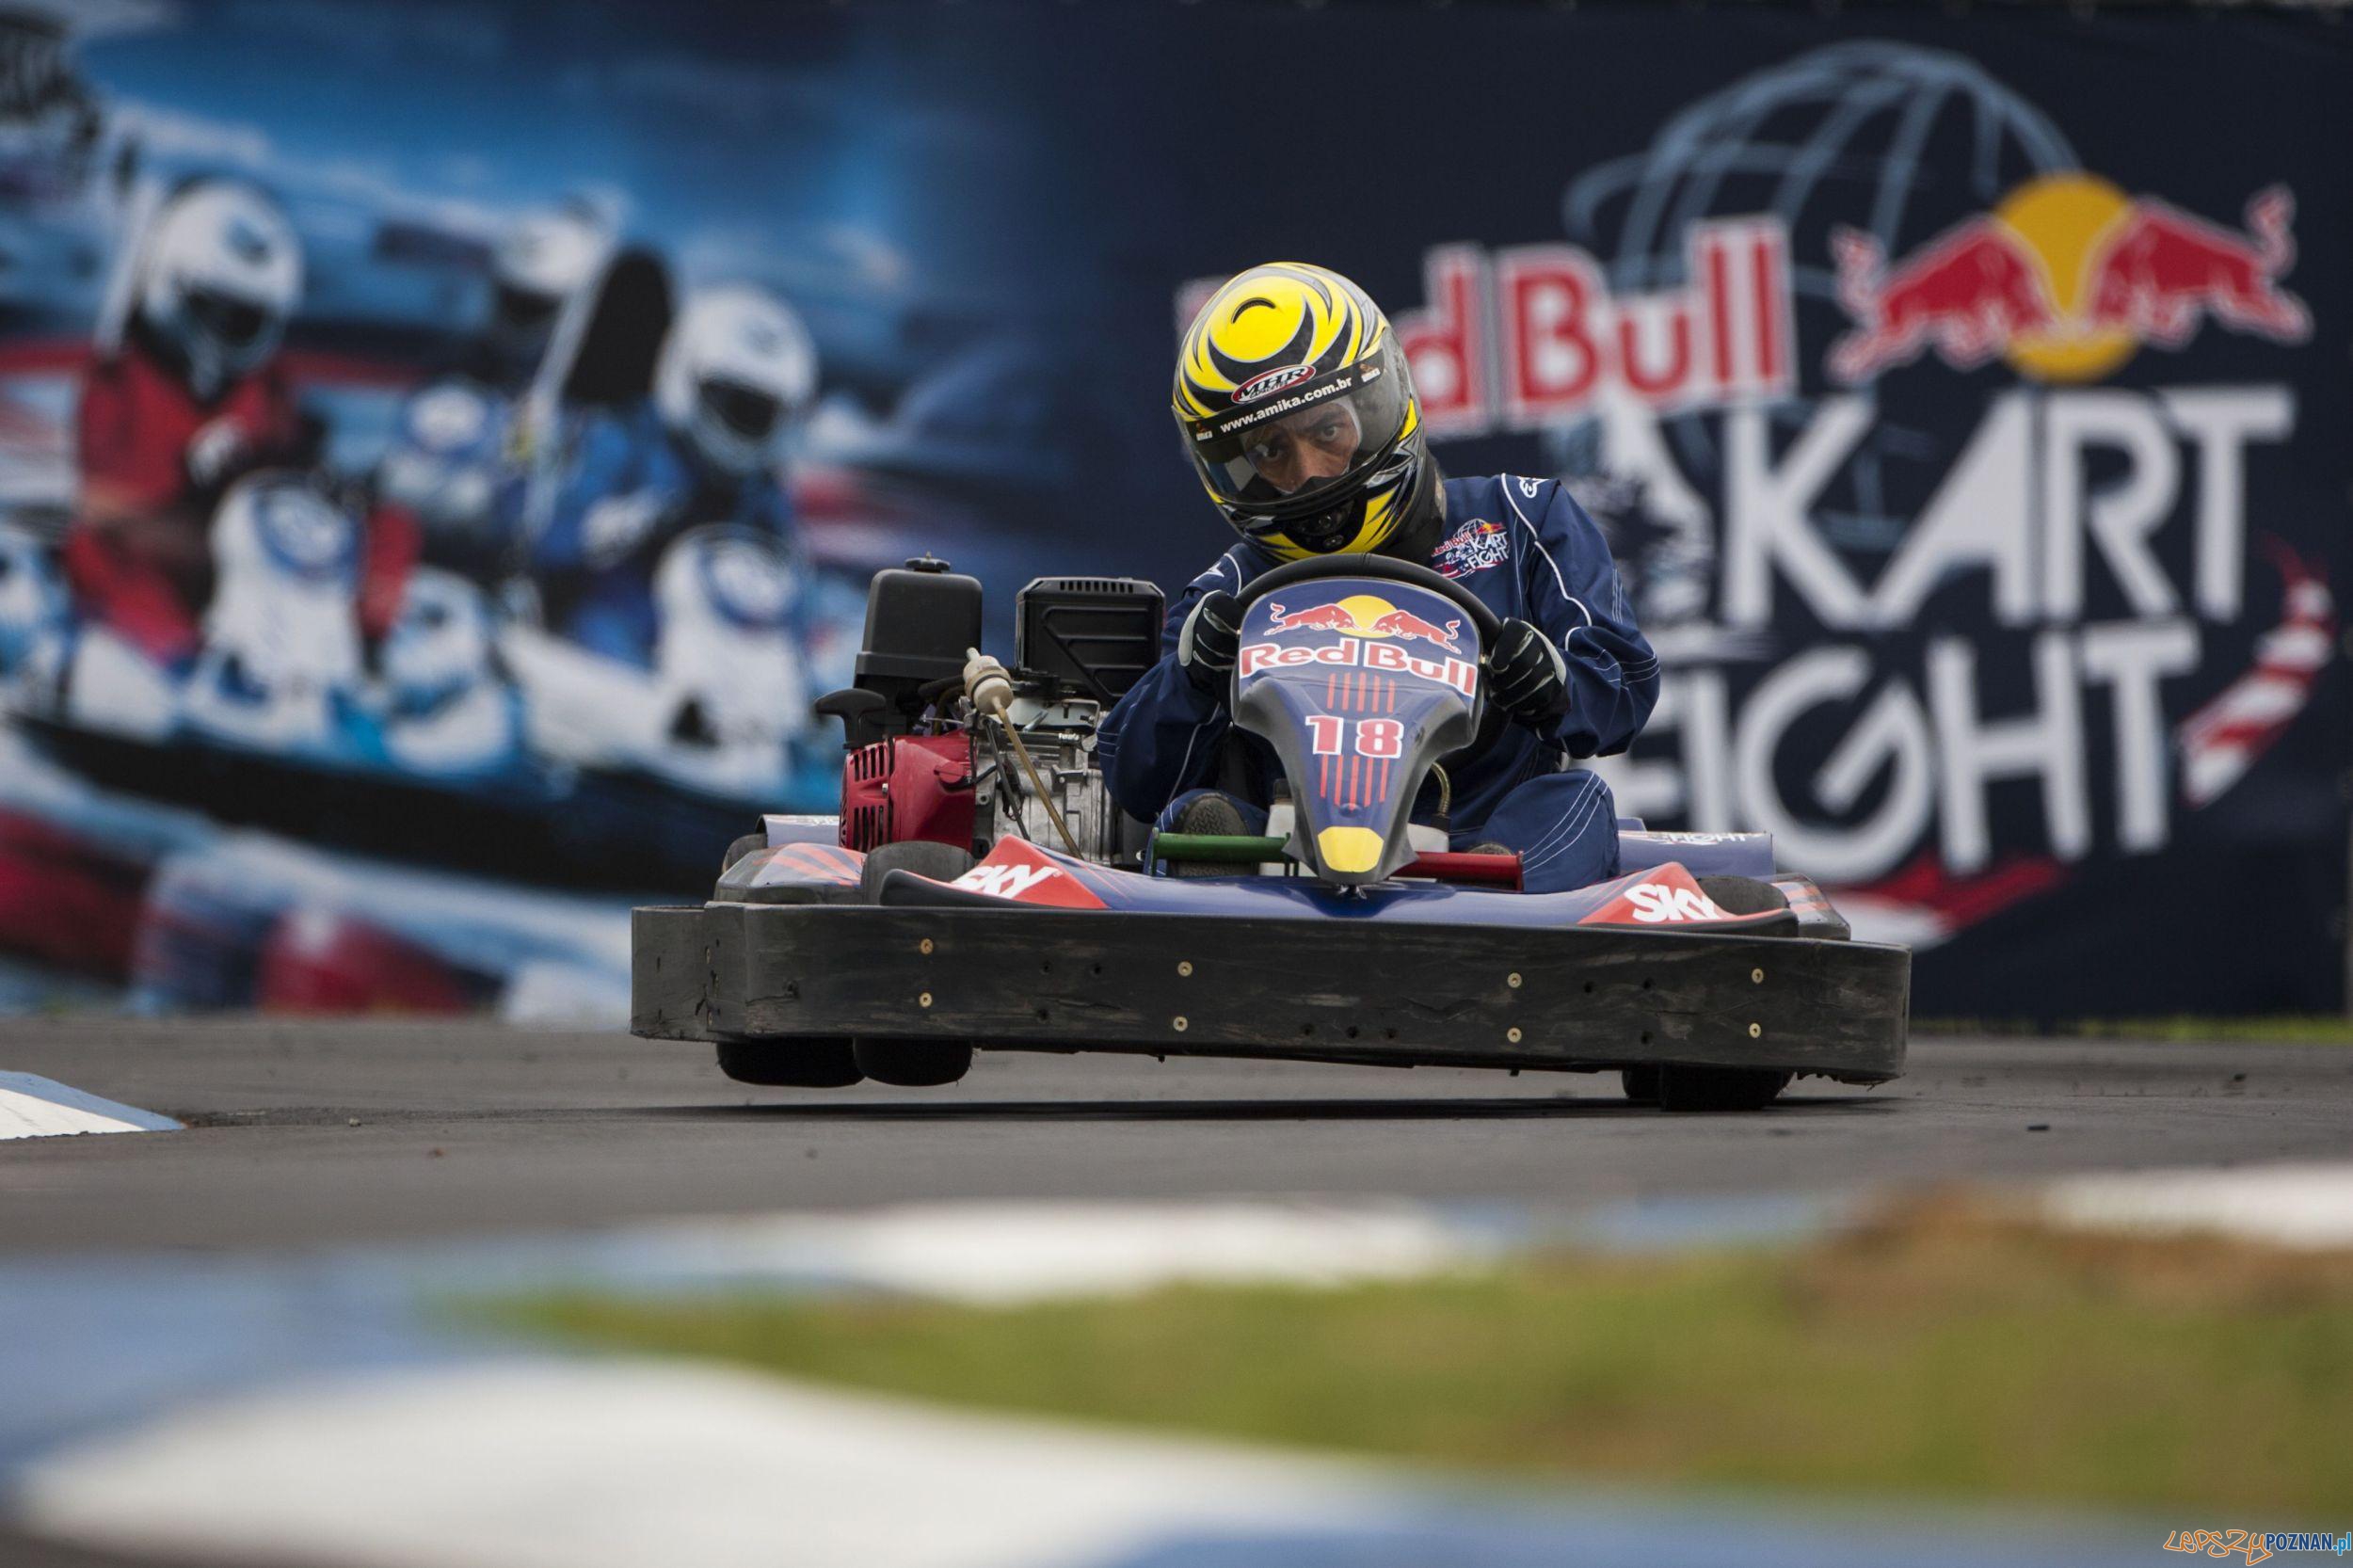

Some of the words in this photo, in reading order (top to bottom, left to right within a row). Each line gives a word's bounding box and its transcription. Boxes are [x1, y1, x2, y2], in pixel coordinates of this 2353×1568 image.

[1501, 216, 1794, 427] Bull
[1220, 376, 1353, 434] www.amika.com.br
[1724, 387, 2293, 629] KART
[1467, 546, 1509, 569] FIGHT
[1468, 532, 1508, 552] KART
[1240, 638, 1359, 680] Red
[1364, 642, 1478, 699] Bull
[1305, 715, 1404, 759] 18
[1624, 883, 1721, 922] SKY
